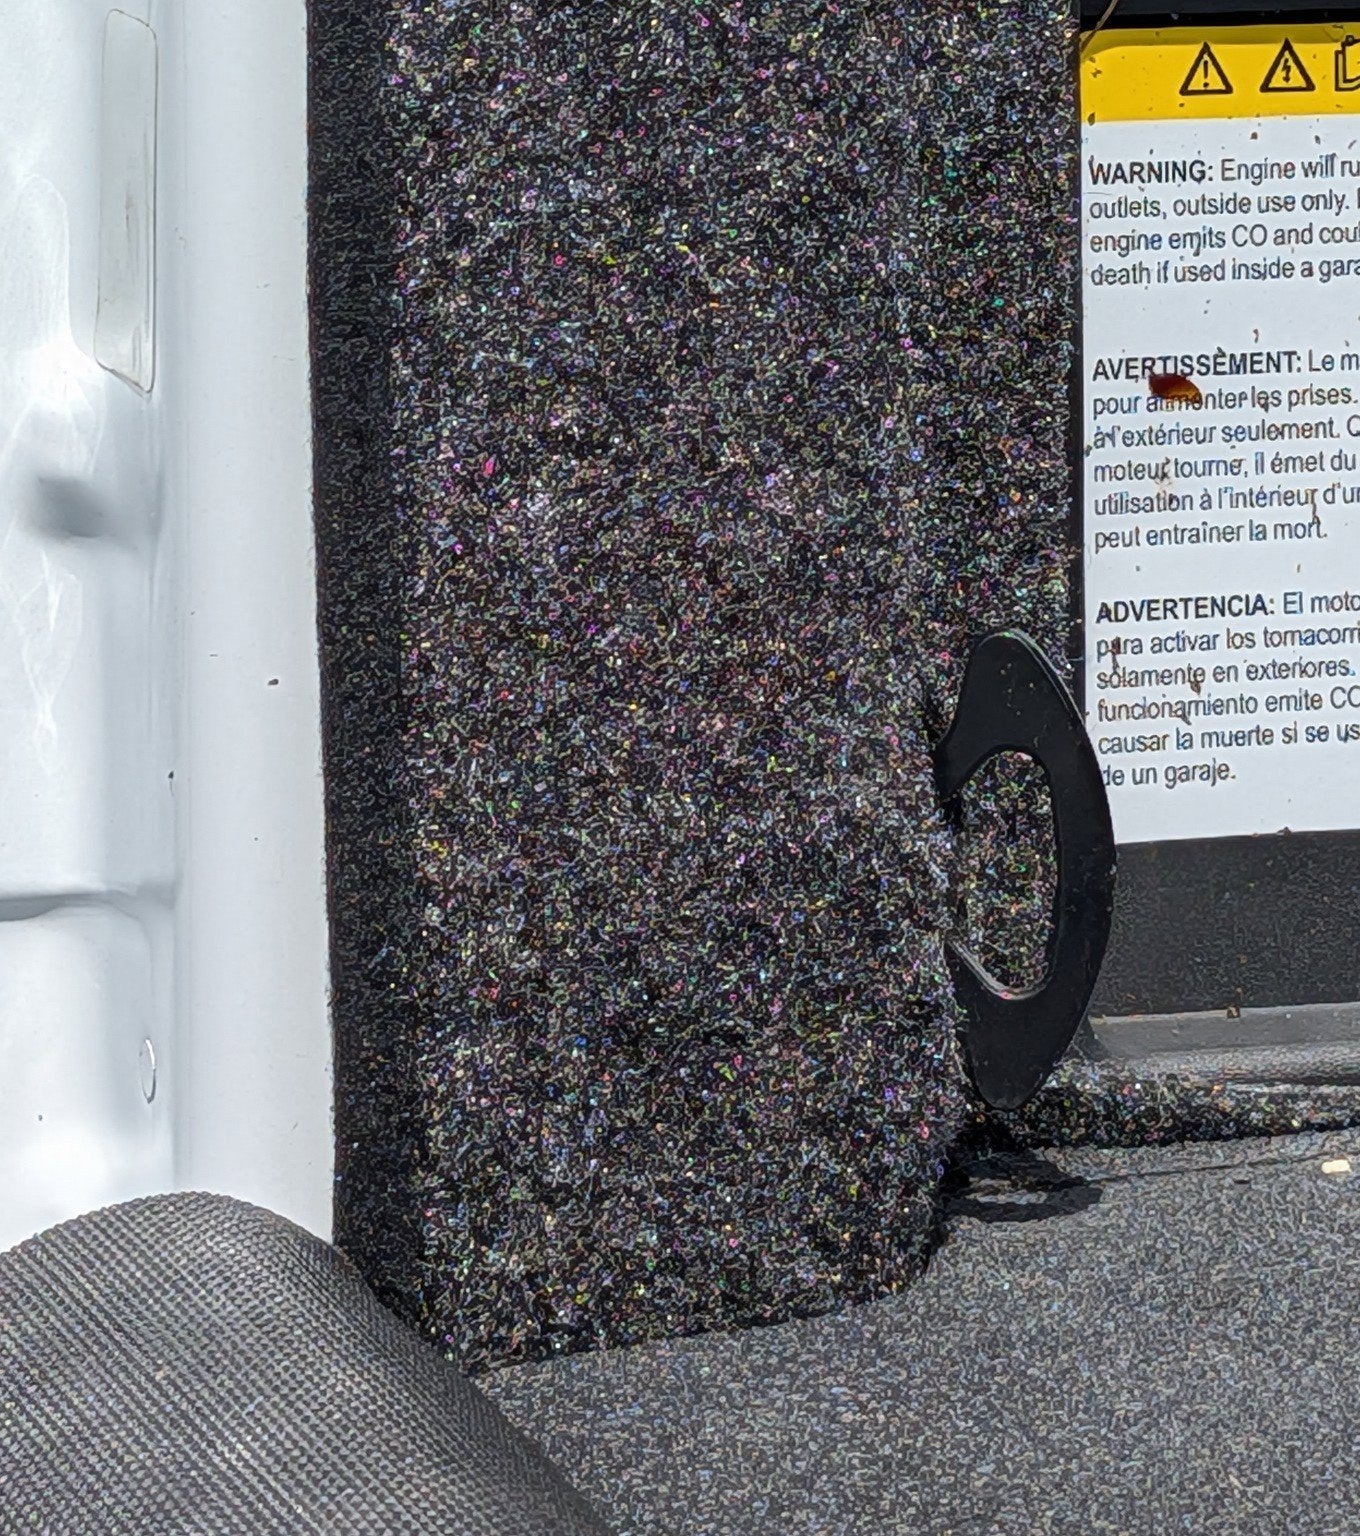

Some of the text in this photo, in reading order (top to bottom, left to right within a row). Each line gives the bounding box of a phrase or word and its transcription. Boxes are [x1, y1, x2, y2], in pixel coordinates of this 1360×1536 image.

[1088, 158, 1213, 186] WARNING:
[1221, 157, 1295, 184] Engine
[1301, 153, 1337, 178] will
[1089, 192, 1167, 219] outlets,
[1173, 192, 1251, 216] outside
[1258, 195, 1296, 213] use
[1301, 189, 1349, 216] only.
[1090, 229, 1162, 256] engine
[1168, 228, 1226, 251] emits
[1232, 224, 1267, 247] CO
[1273, 222, 1313, 246] and
[1091, 262, 1150, 286] death
[1157, 260, 1169, 282] if
[1174, 259, 1225, 282] used
[1232, 257, 1295, 281] inside
[1301, 261, 1314, 277] a
[1309, 350, 1334, 372] Le
[1093, 396, 1142, 420] pour
[1251, 386, 1282, 408] les
[1288, 383, 1358, 412] prises.
[1094, 429, 1106, 449] à
[1110, 422, 1216, 447] l'extérieur
[1222, 417, 1340, 443] seulement.
[1094, 458, 1170, 483] moteur
[1174, 458, 1248, 478] tourne,
[1255, 452, 1264, 475] il
[1271, 451, 1325, 473] émet
[1331, 449, 1356, 471] du
[1095, 490, 1193, 515] utilisation
[1199, 488, 1212, 510] à
[1219, 485, 1318, 510] l'intérieur
[1095, 517, 1327, 554] peut entraîner la mort.
[1096, 594, 1274, 624] ADVERTENCIA:
[1284, 592, 1303, 614] El
[1097, 636, 1143, 663] para
[1150, 630, 1220, 653] activar
[1226, 628, 1256, 649] los
[1097, 665, 1205, 690] solamente
[1213, 665, 1238, 683] en
[1245, 656, 1355, 681] exteriores.
[1098, 692, 1258, 722] funcionamiento
[1265, 688, 1322, 711] emite
[1098, 734, 1170, 754] causar
[1176, 727, 1193, 750] la
[1201, 725, 1274, 748] muerte
[1282, 721, 1297, 743] si
[1305, 726, 1329, 743] se
[1132, 767, 1157, 785] un
[1165, 758, 1235, 789] garaje.
